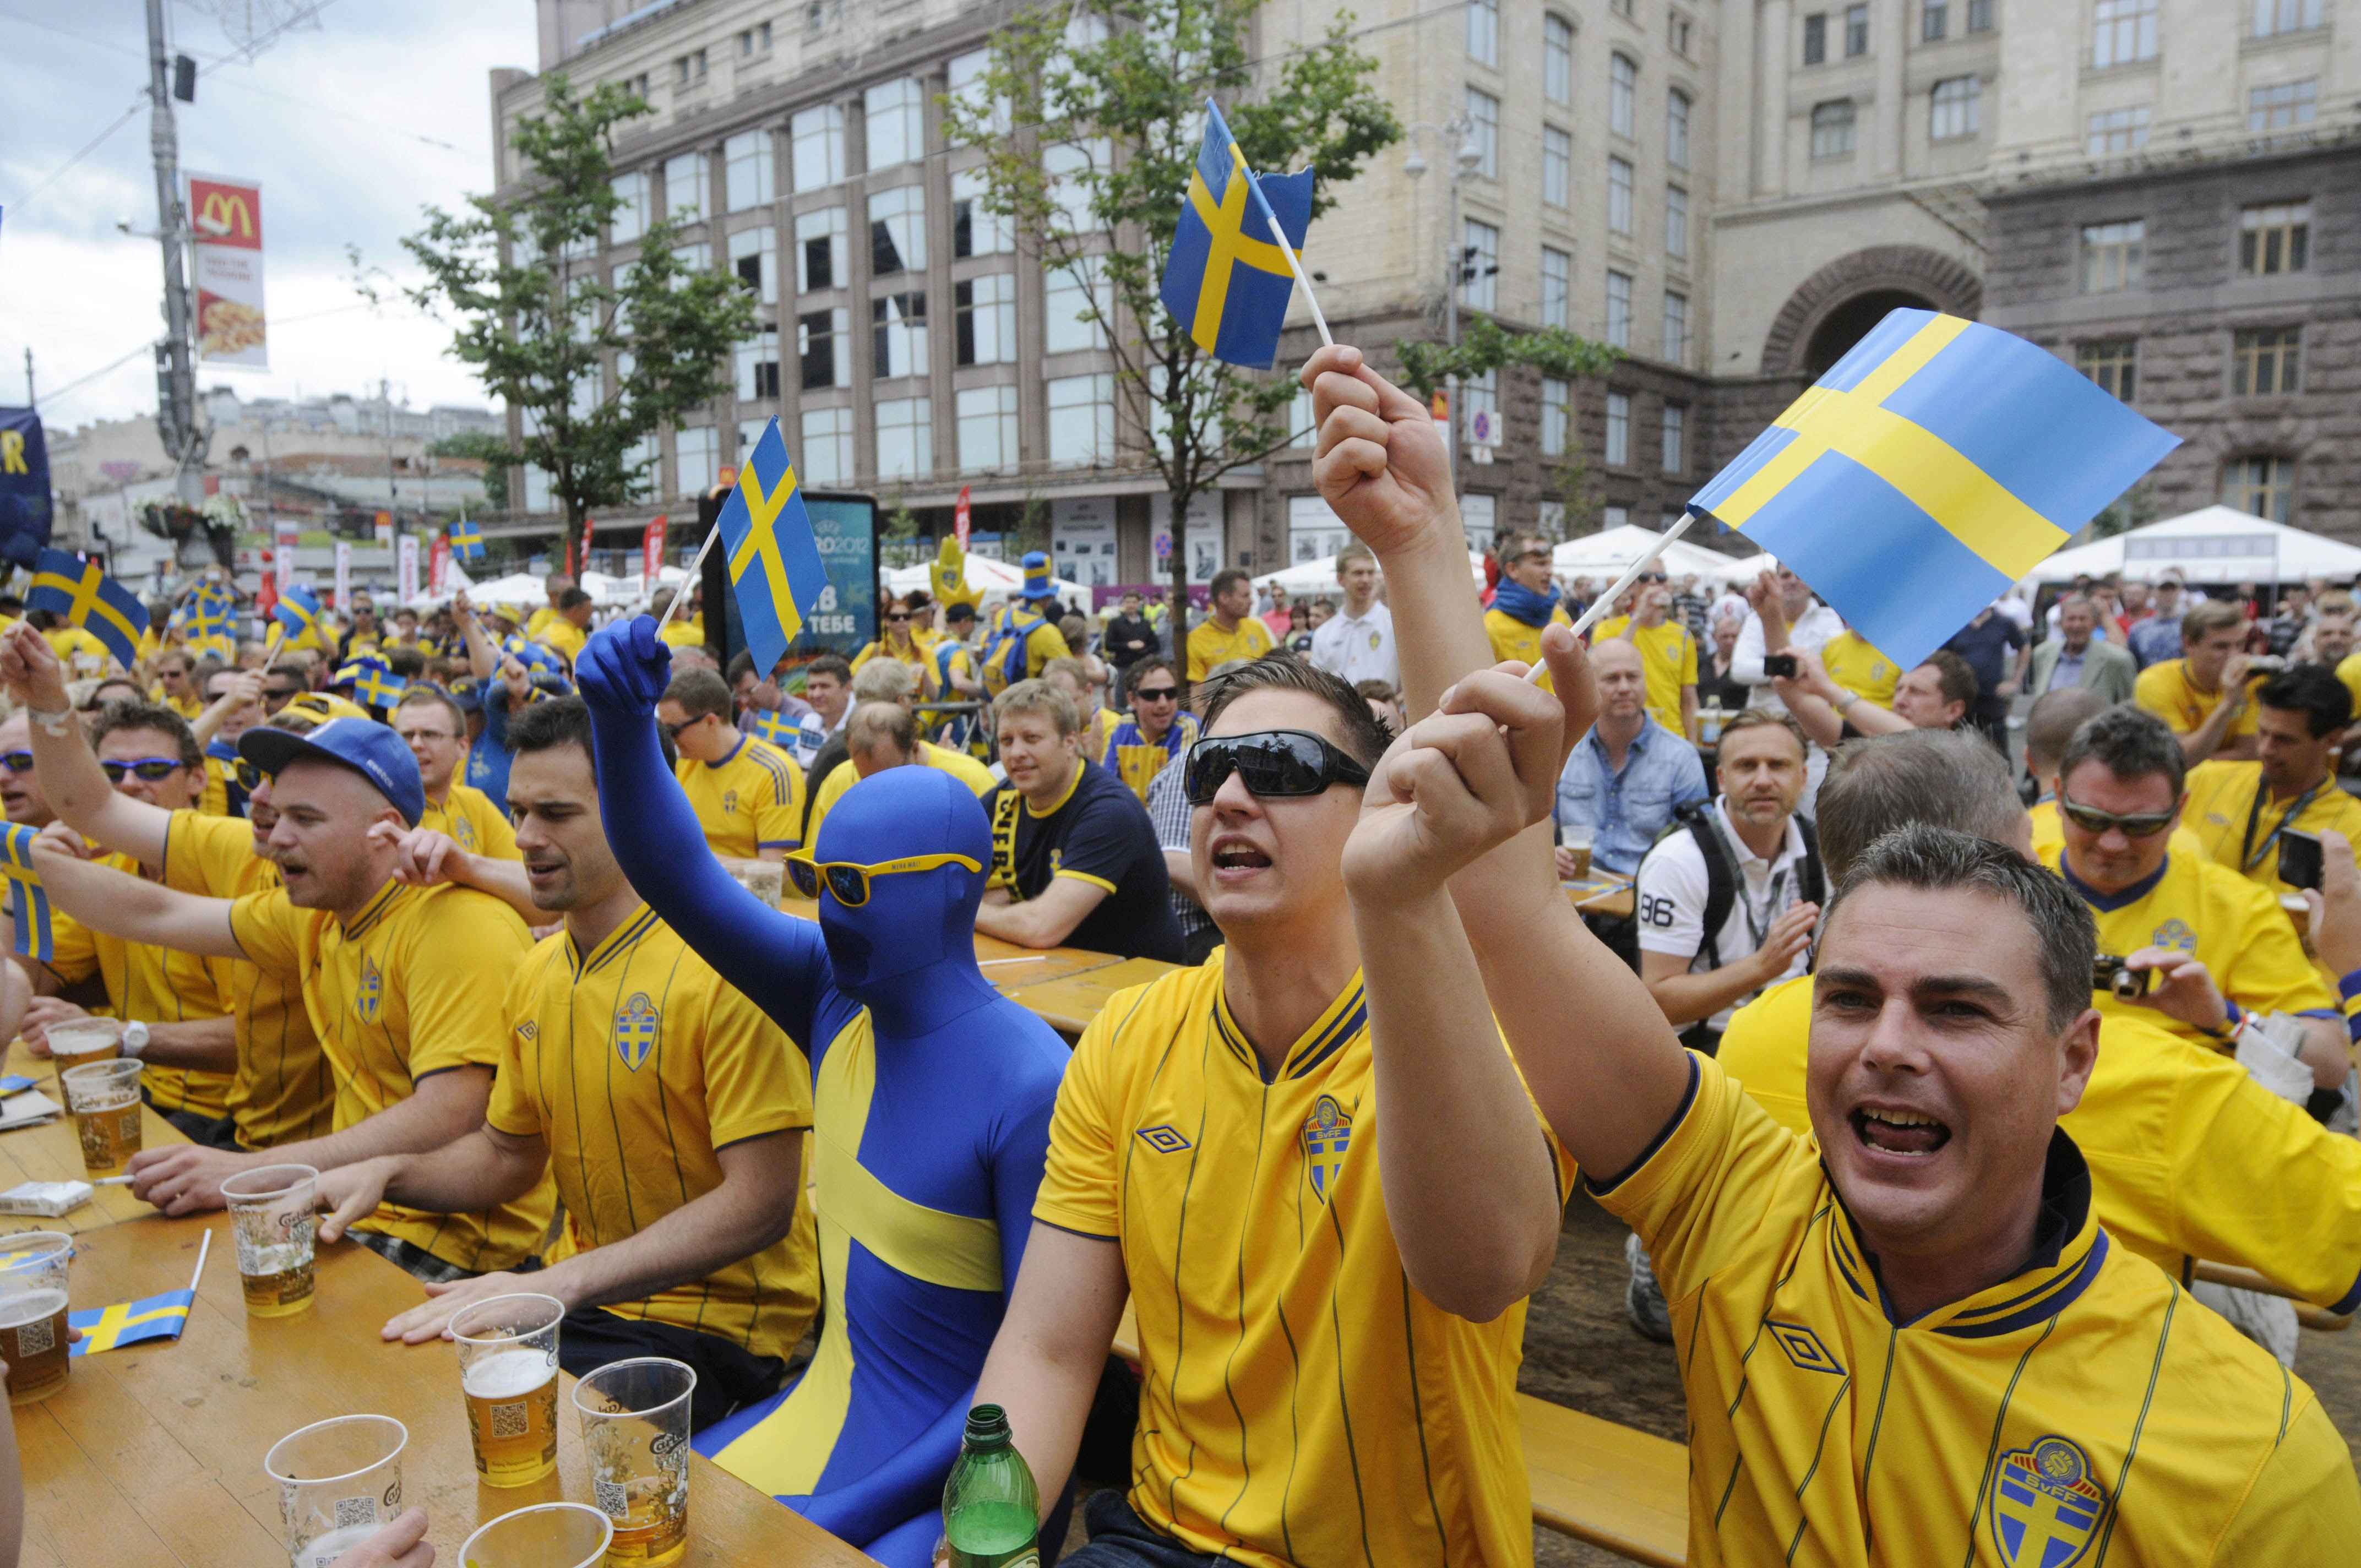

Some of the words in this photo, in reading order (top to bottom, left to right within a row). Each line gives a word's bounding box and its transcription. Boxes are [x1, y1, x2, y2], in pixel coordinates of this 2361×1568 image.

[0, 430, 28, 475] R
[808, 614, 856, 634] ТЕБЕ
[1316, 1129, 1342, 1139] SvFF
[2025, 1473, 2078, 1502] SvFF
